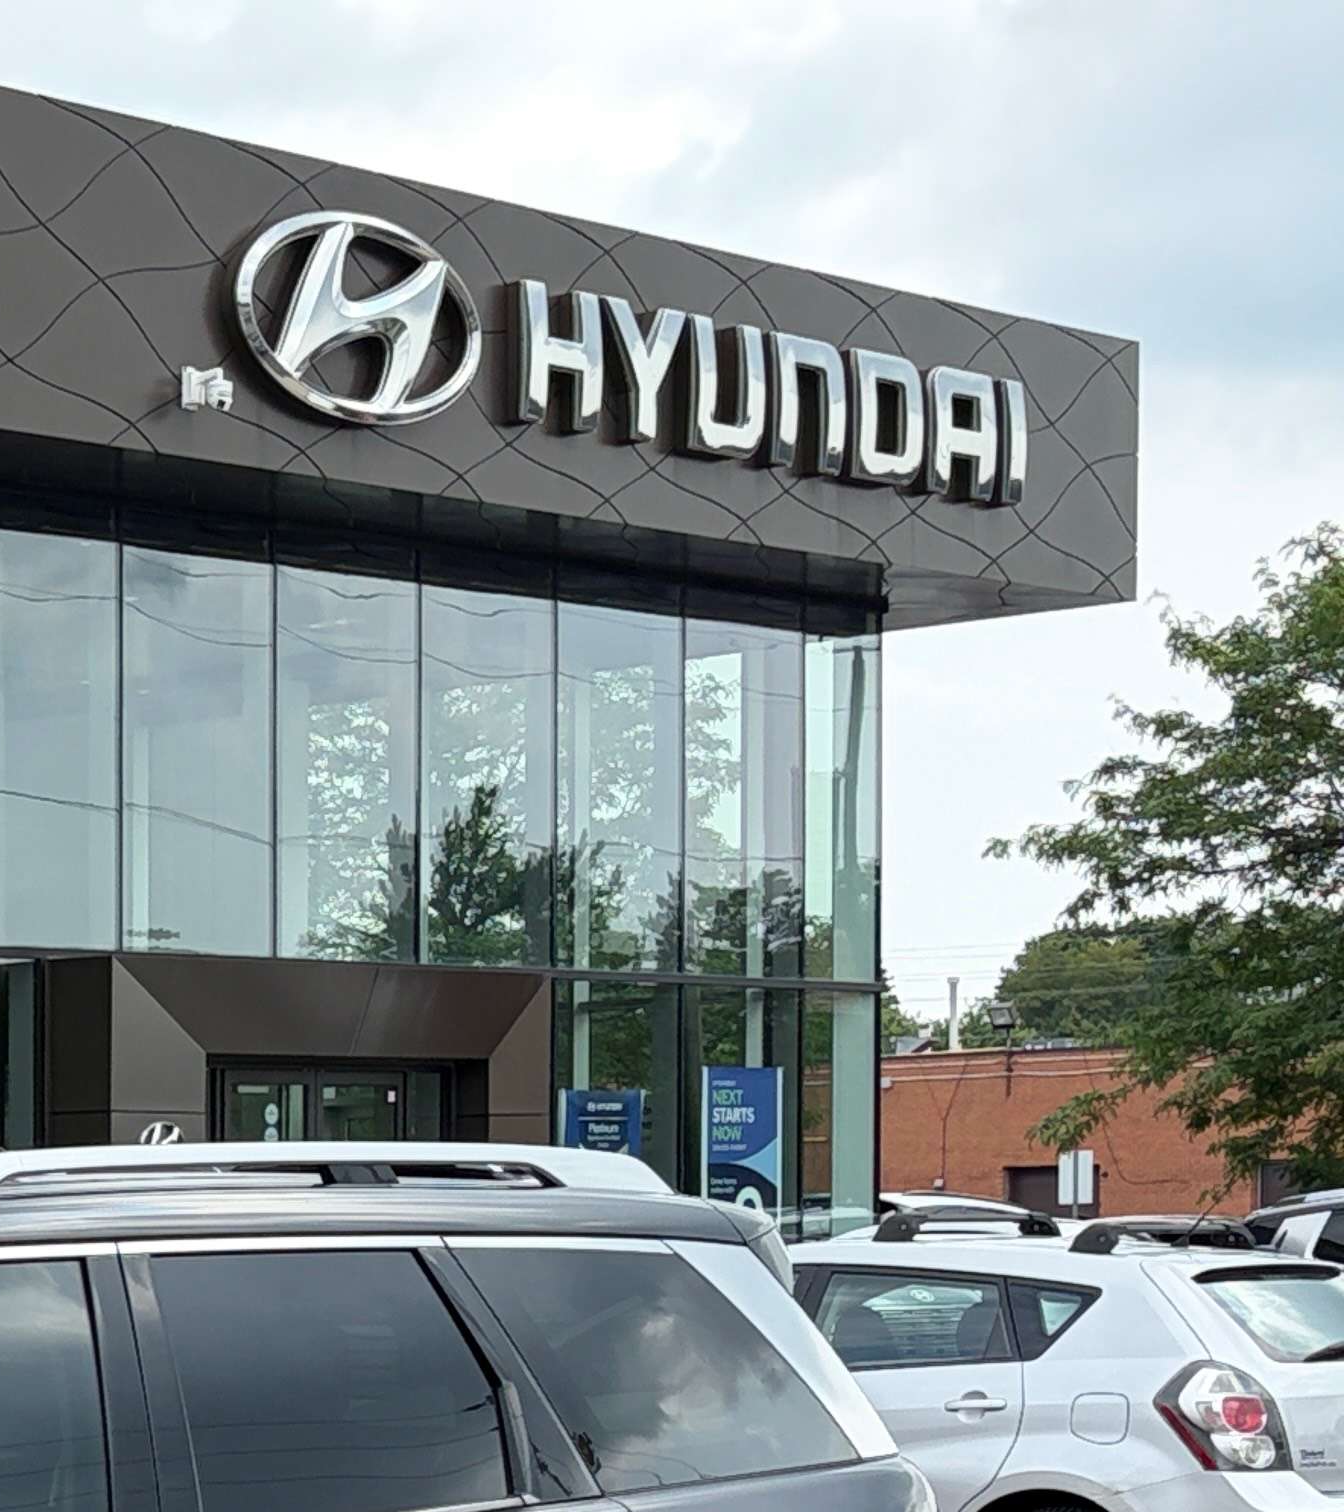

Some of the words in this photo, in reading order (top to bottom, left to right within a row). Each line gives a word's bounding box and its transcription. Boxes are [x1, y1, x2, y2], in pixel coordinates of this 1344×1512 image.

[510, 279, 1028, 507] HYUNDAI
[712, 1089, 744, 1106] NEXT
[712, 1107, 756, 1124] STARTS
[712, 1125, 743, 1142] NOW
